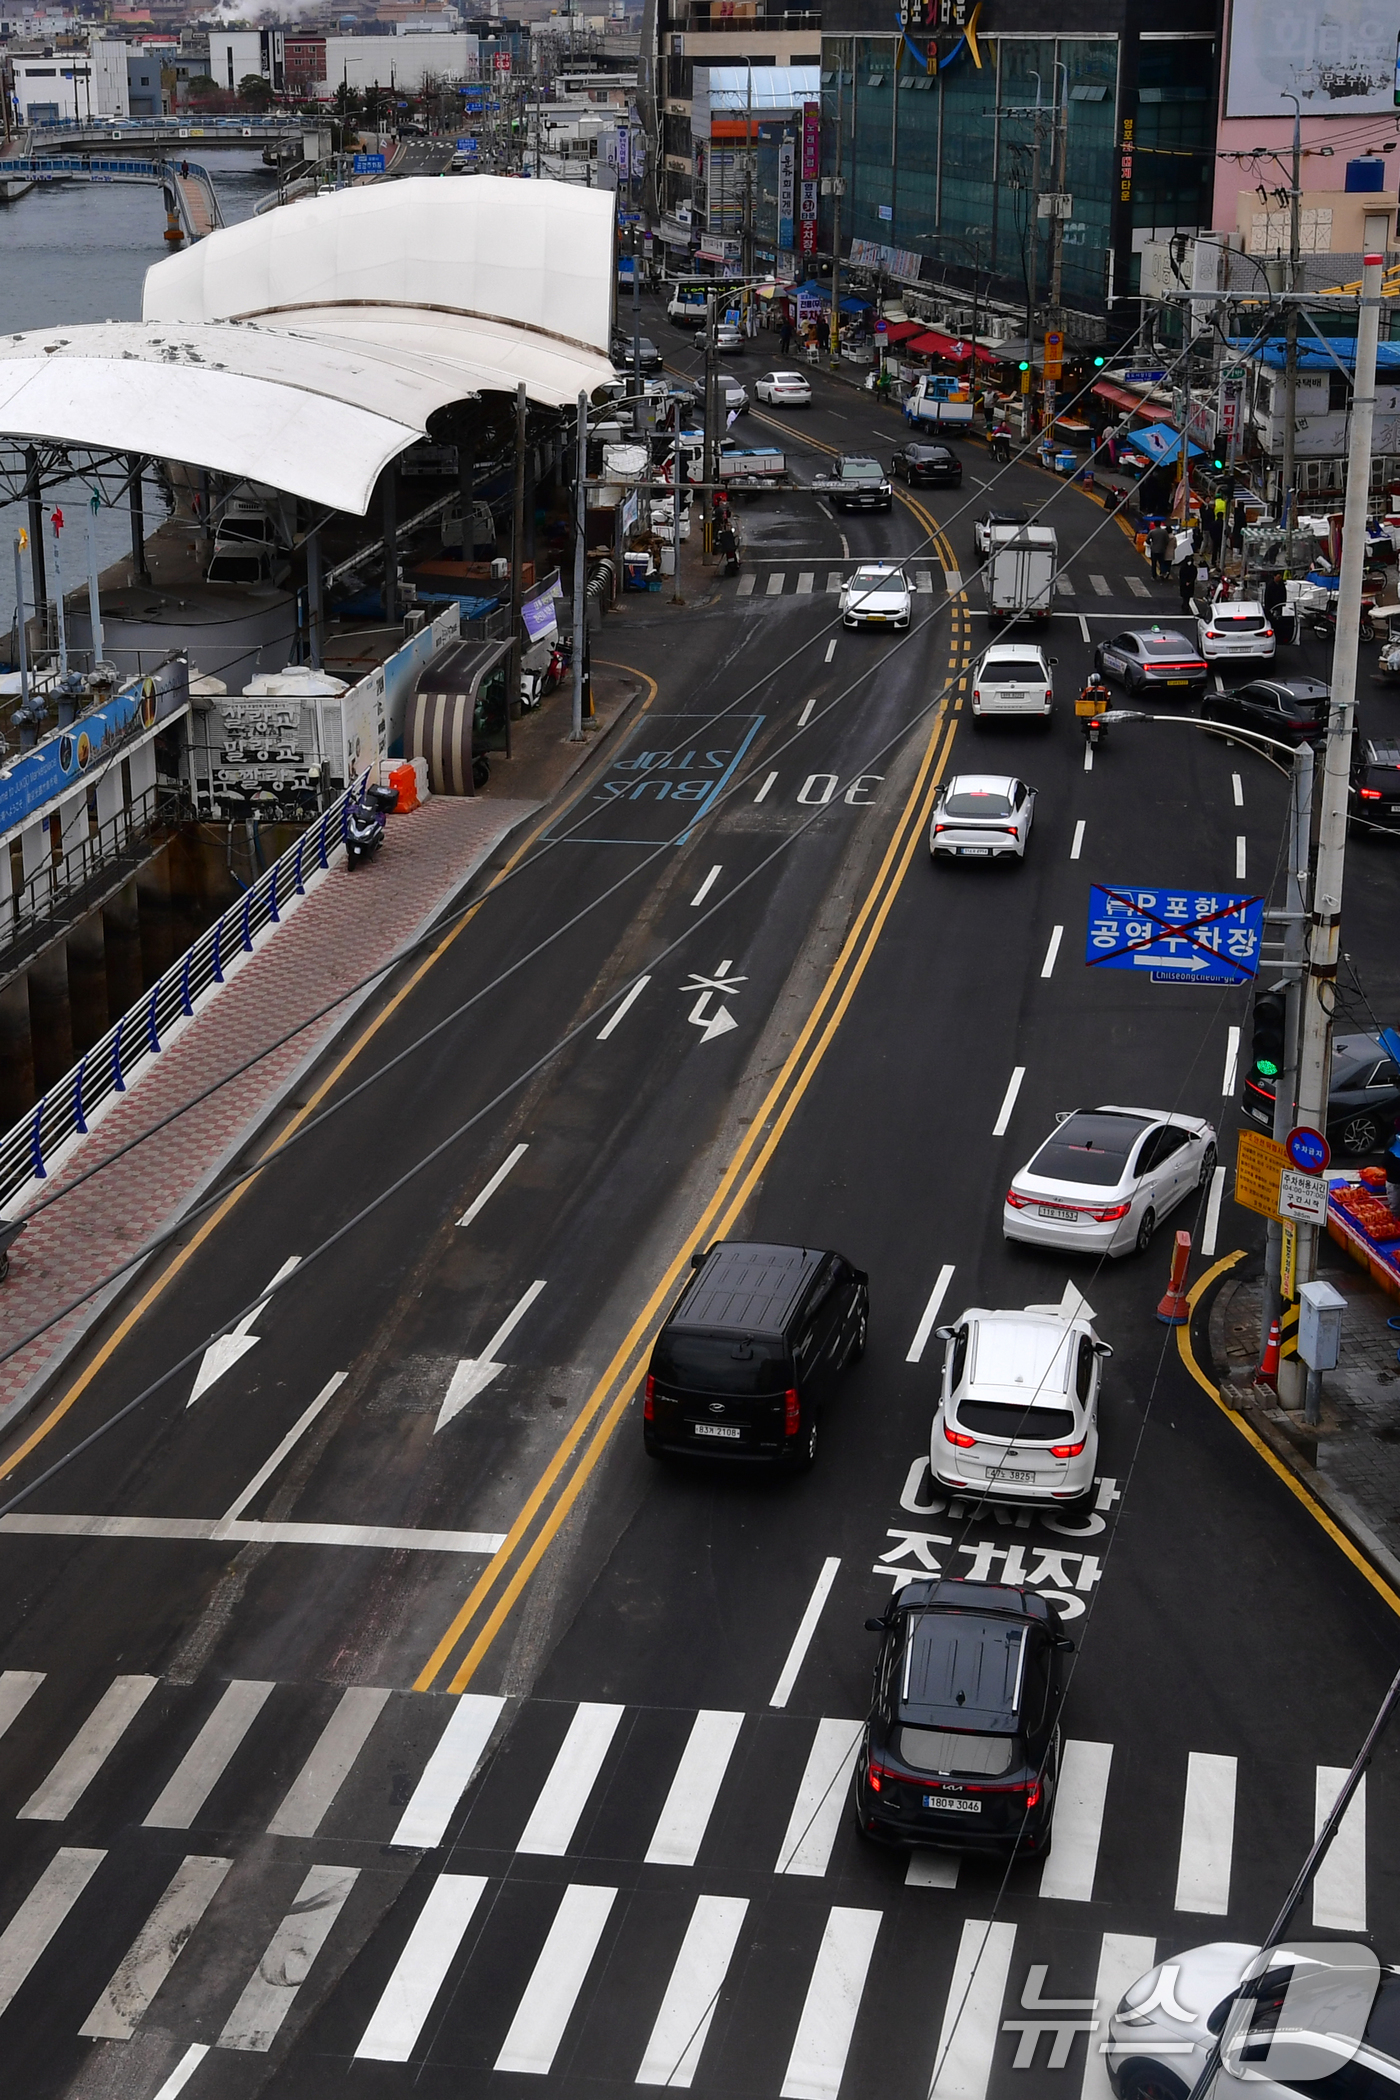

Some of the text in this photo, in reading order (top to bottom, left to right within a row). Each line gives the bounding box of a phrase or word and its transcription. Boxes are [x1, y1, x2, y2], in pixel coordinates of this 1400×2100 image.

[802, 221, 814, 249] 주차장
[613, 749, 733, 771] STOP
[593, 780, 715, 802] BUS
[796, 773, 886, 805] 30
[1163, 896, 1248, 924] 포항시
[1090, 919, 1258, 957] 공영주차장
[1293, 1142, 1323, 1158] 주차금지
[716, 1427, 737, 1437] 2108
[1009, 1471, 1031, 1481] 3825
[872, 1528, 1103, 1621] 주차장
[956, 1799, 980, 1812] 3046
